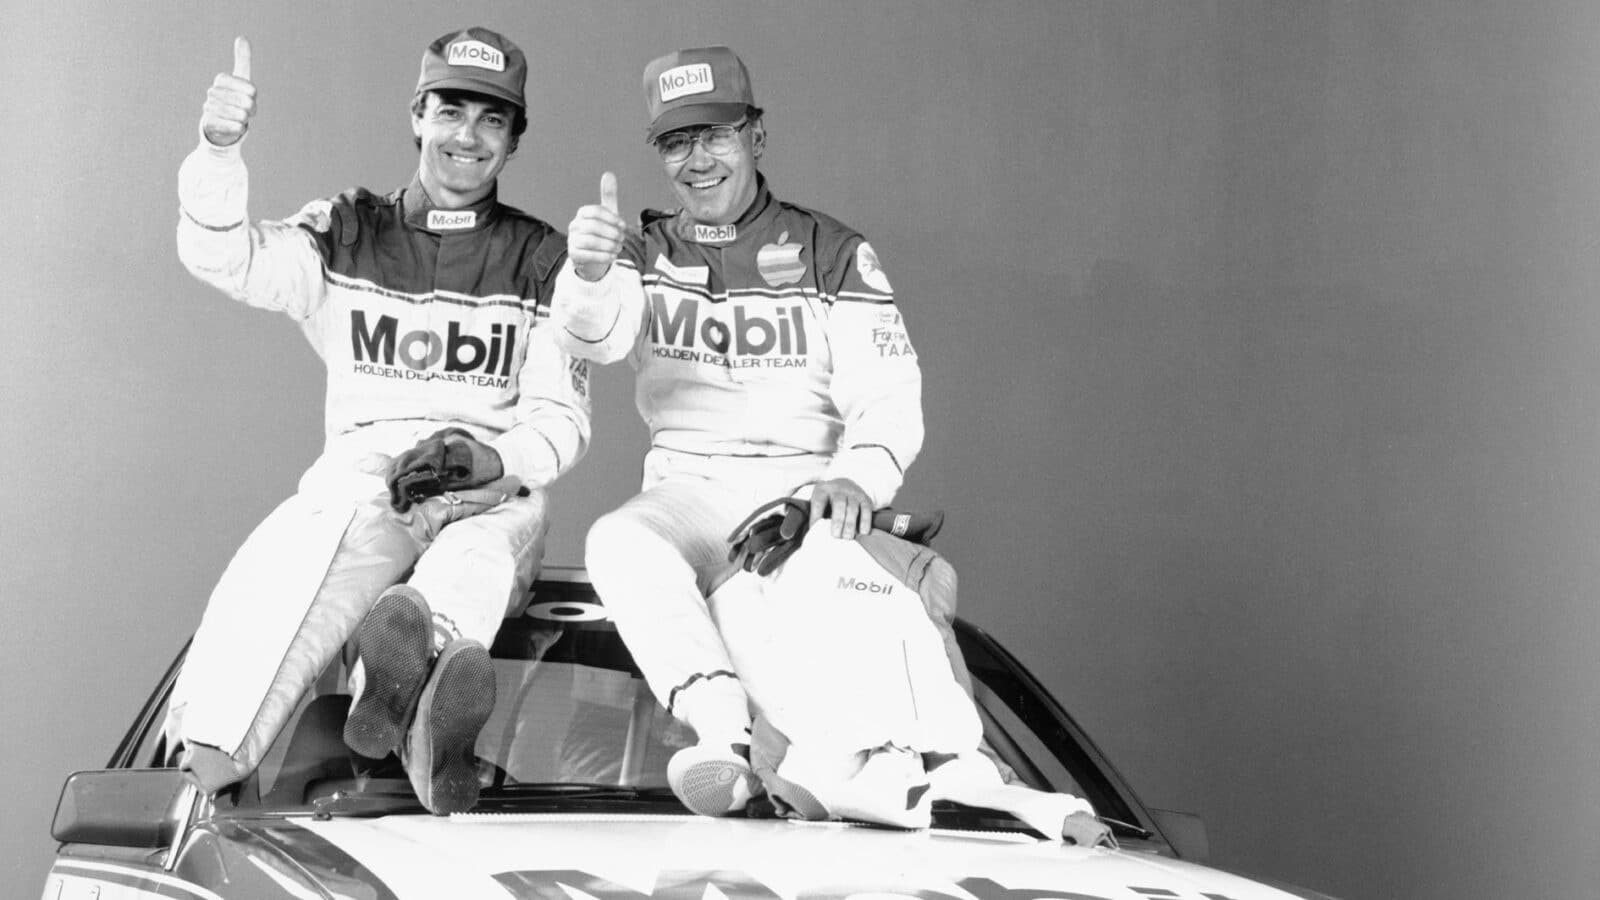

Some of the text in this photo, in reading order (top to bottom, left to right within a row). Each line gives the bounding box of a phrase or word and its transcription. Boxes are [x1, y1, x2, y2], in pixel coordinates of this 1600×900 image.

[452, 45, 501, 66] Mobil
[661, 67, 708, 93] Mobil
[432, 213, 471, 225] Mobil
[698, 225, 735, 240] Mobil
[651, 293, 808, 356] Mobil
[351, 309, 516, 377] Mobil
[876, 343, 914, 357] TAA
[652, 347, 807, 369] HOLDEN DEALER TEAM
[353, 363, 403, 379] HOLDEN
[470, 374, 511, 389] TEAM
[837, 576, 893, 595] Mobil
